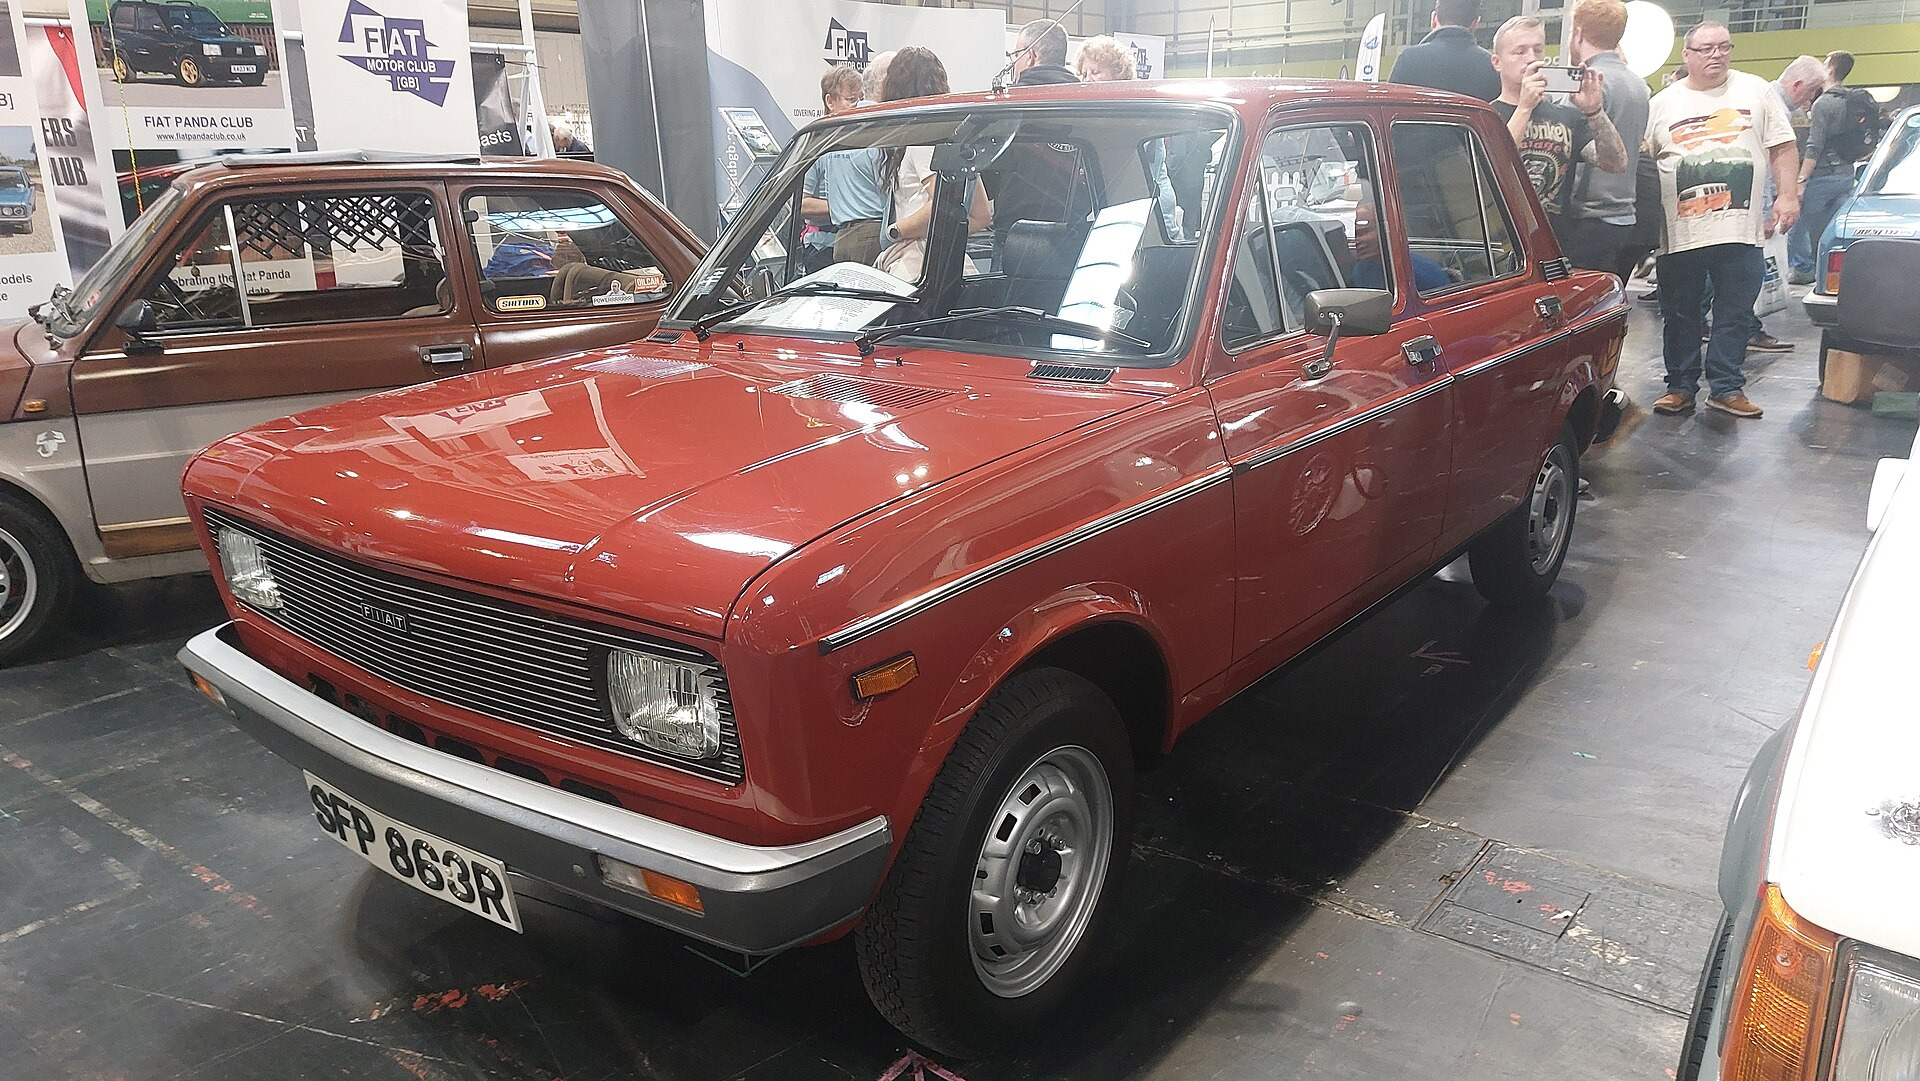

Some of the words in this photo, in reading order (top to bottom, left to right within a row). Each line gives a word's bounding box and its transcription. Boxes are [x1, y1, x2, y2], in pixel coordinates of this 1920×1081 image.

[364, 27, 421, 57] FIAT
[837, 37, 866, 59] FIAT
[366, 59, 405, 72] MOTOR
[407, 61, 437, 73] CLUB
[397, 76, 420, 91] [GB]
[144, 116, 172, 128] FIAT
[175, 116, 218, 128] PANDA
[220, 117, 254, 128] CLUB
[156, 132, 247, 142] www.fiatpandaclub.co.uk
[49, 156, 88, 186] LUB
[0, 273, 33, 285] odels
[259, 268, 291, 280] Panda
[364, 606, 403, 628] FIAT
[310, 784, 376, 856] SFP
[384, 826, 512, 924] 863R
